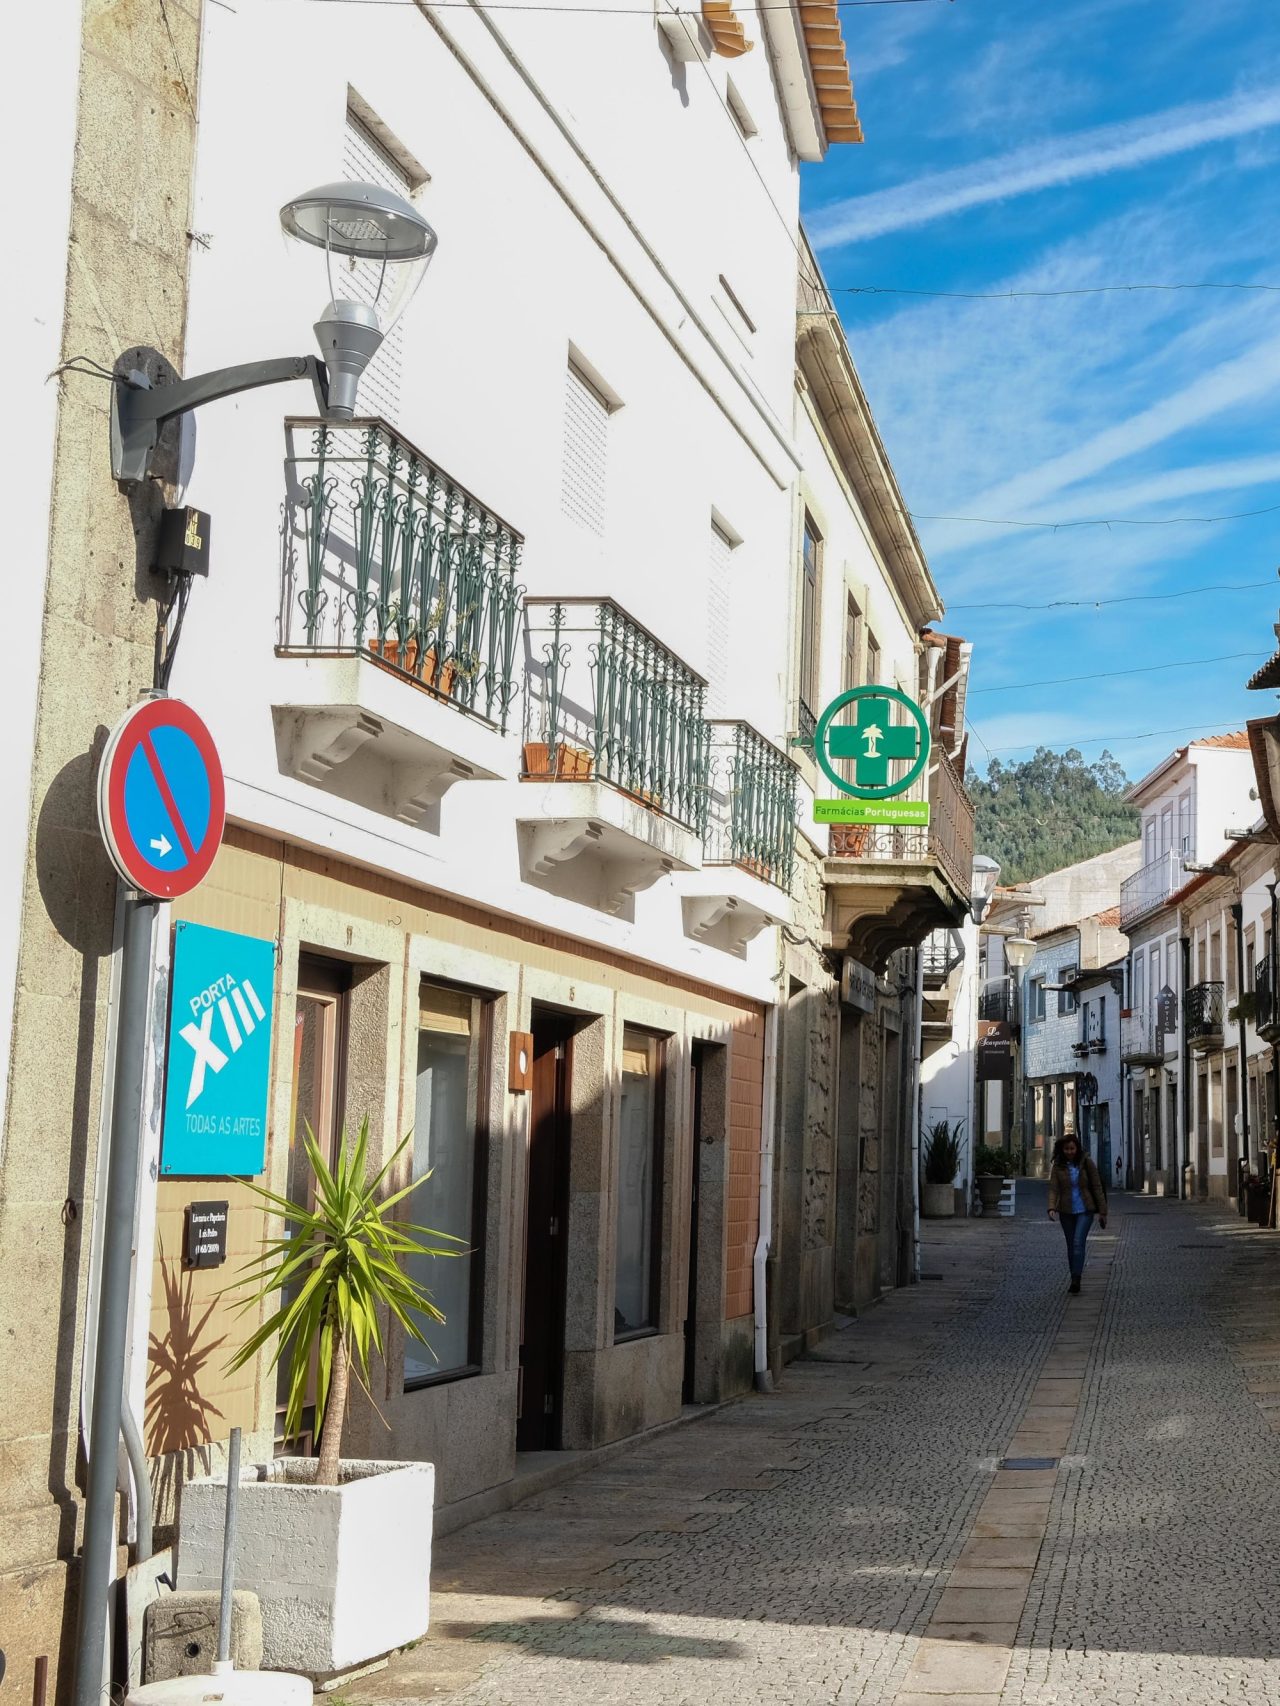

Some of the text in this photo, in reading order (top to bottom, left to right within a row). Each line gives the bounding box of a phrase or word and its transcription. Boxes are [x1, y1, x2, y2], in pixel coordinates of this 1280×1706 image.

[189, 973, 236, 1016] PORTA
[178, 978, 266, 1110] XIII
[186, 1113, 261, 1137] TODAS AS ARTES
